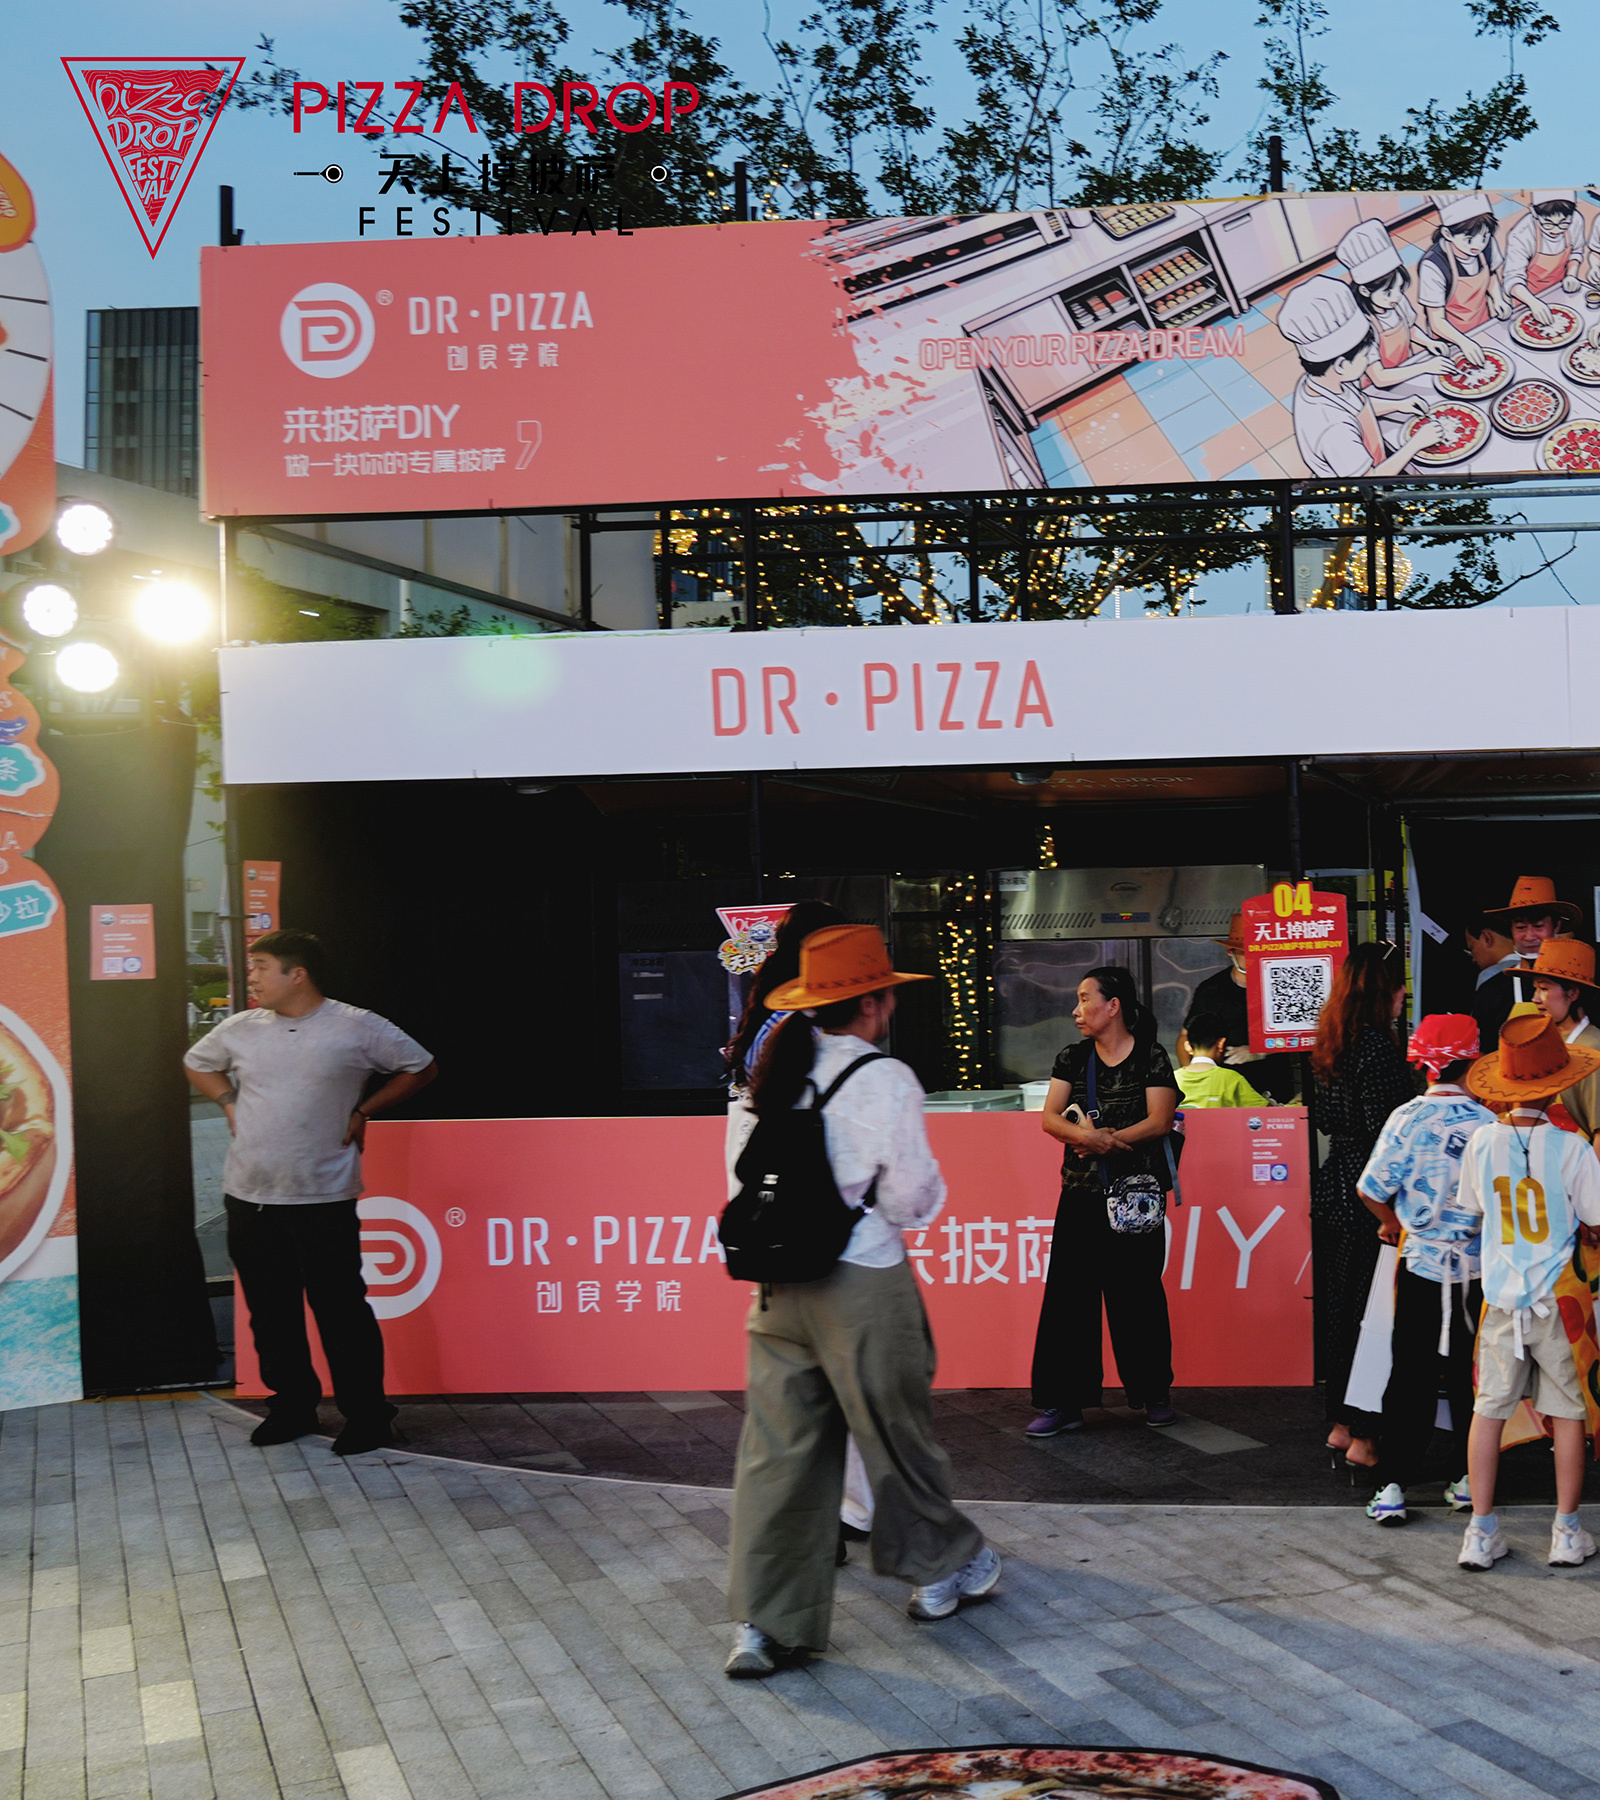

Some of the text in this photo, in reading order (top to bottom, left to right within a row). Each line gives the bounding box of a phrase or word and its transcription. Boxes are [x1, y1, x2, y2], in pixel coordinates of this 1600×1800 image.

[447, 342, 560, 371] 创食学院
[920, 324, 1245, 370] OPEN YOUR PIZZA DREAM
[282, 403, 461, 444] 来披萨DIY
[283, 447, 507, 478] 做一块你的专属披萨
[1273, 883, 1313, 918] 04
[1254, 919, 1335, 942] 天上掉披萨
[1493, 1175, 1550, 1245] 10
[536, 1279, 682, 1313] 创食学院
